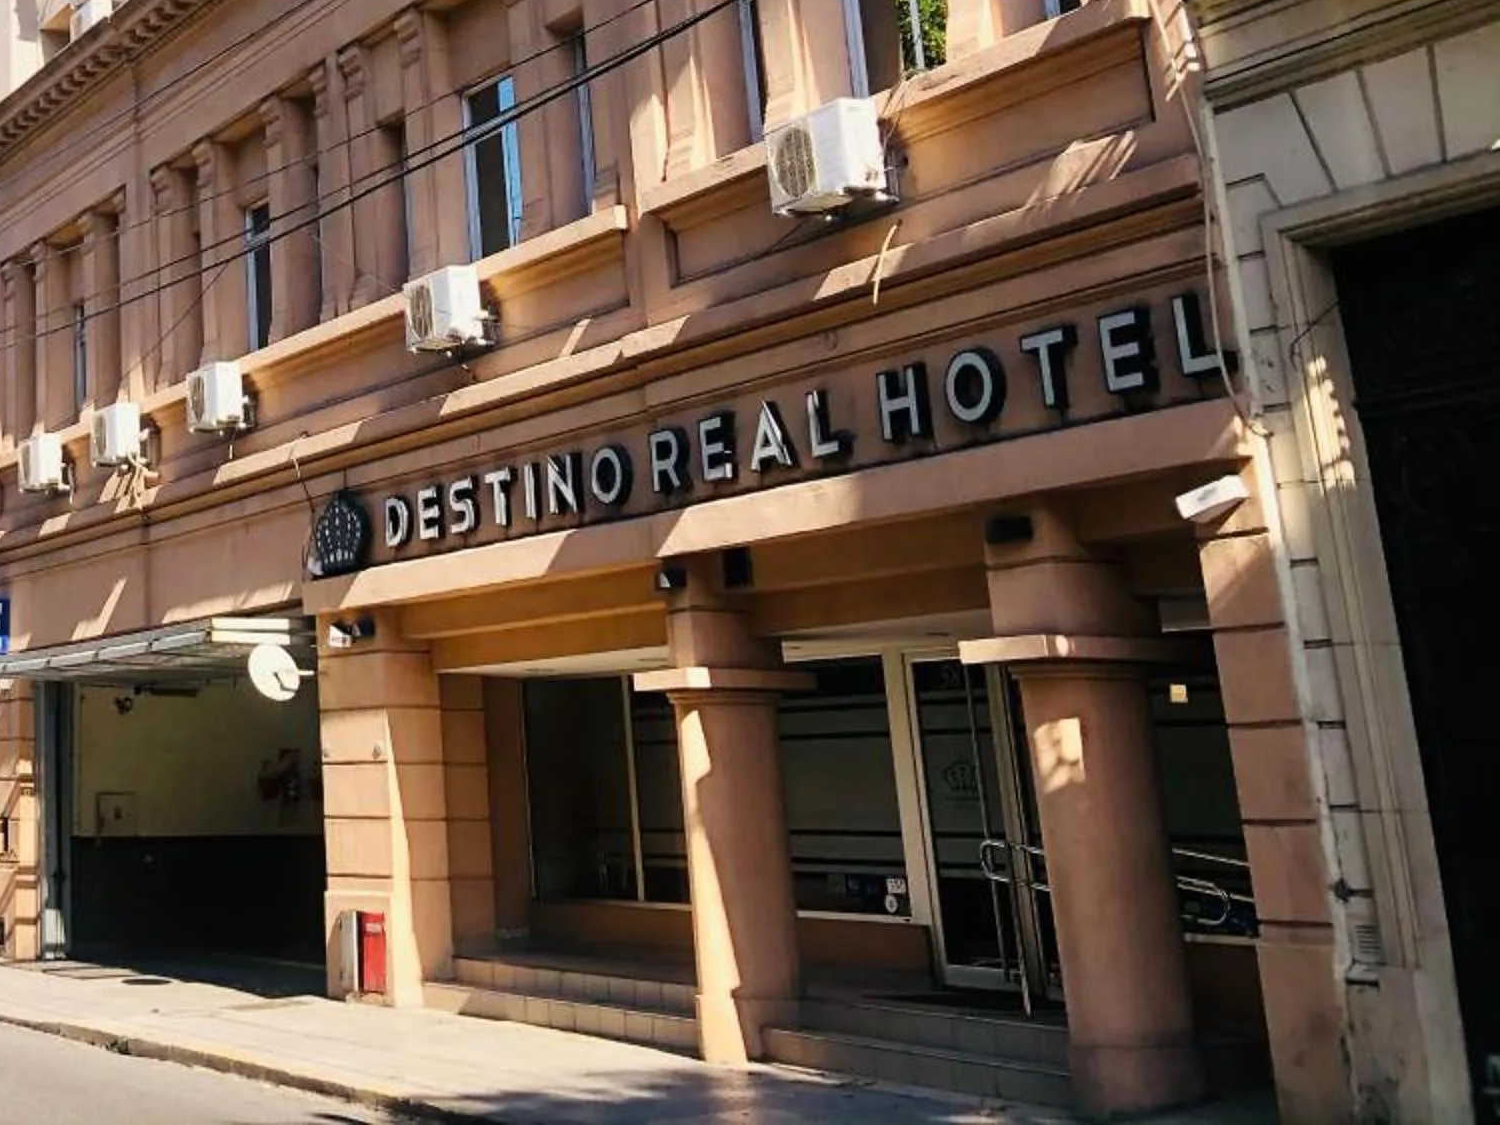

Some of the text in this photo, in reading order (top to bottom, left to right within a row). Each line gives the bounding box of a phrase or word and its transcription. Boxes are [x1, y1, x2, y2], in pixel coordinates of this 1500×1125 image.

[384, 290, 1235, 548] DESTINO REAL HOTEL
